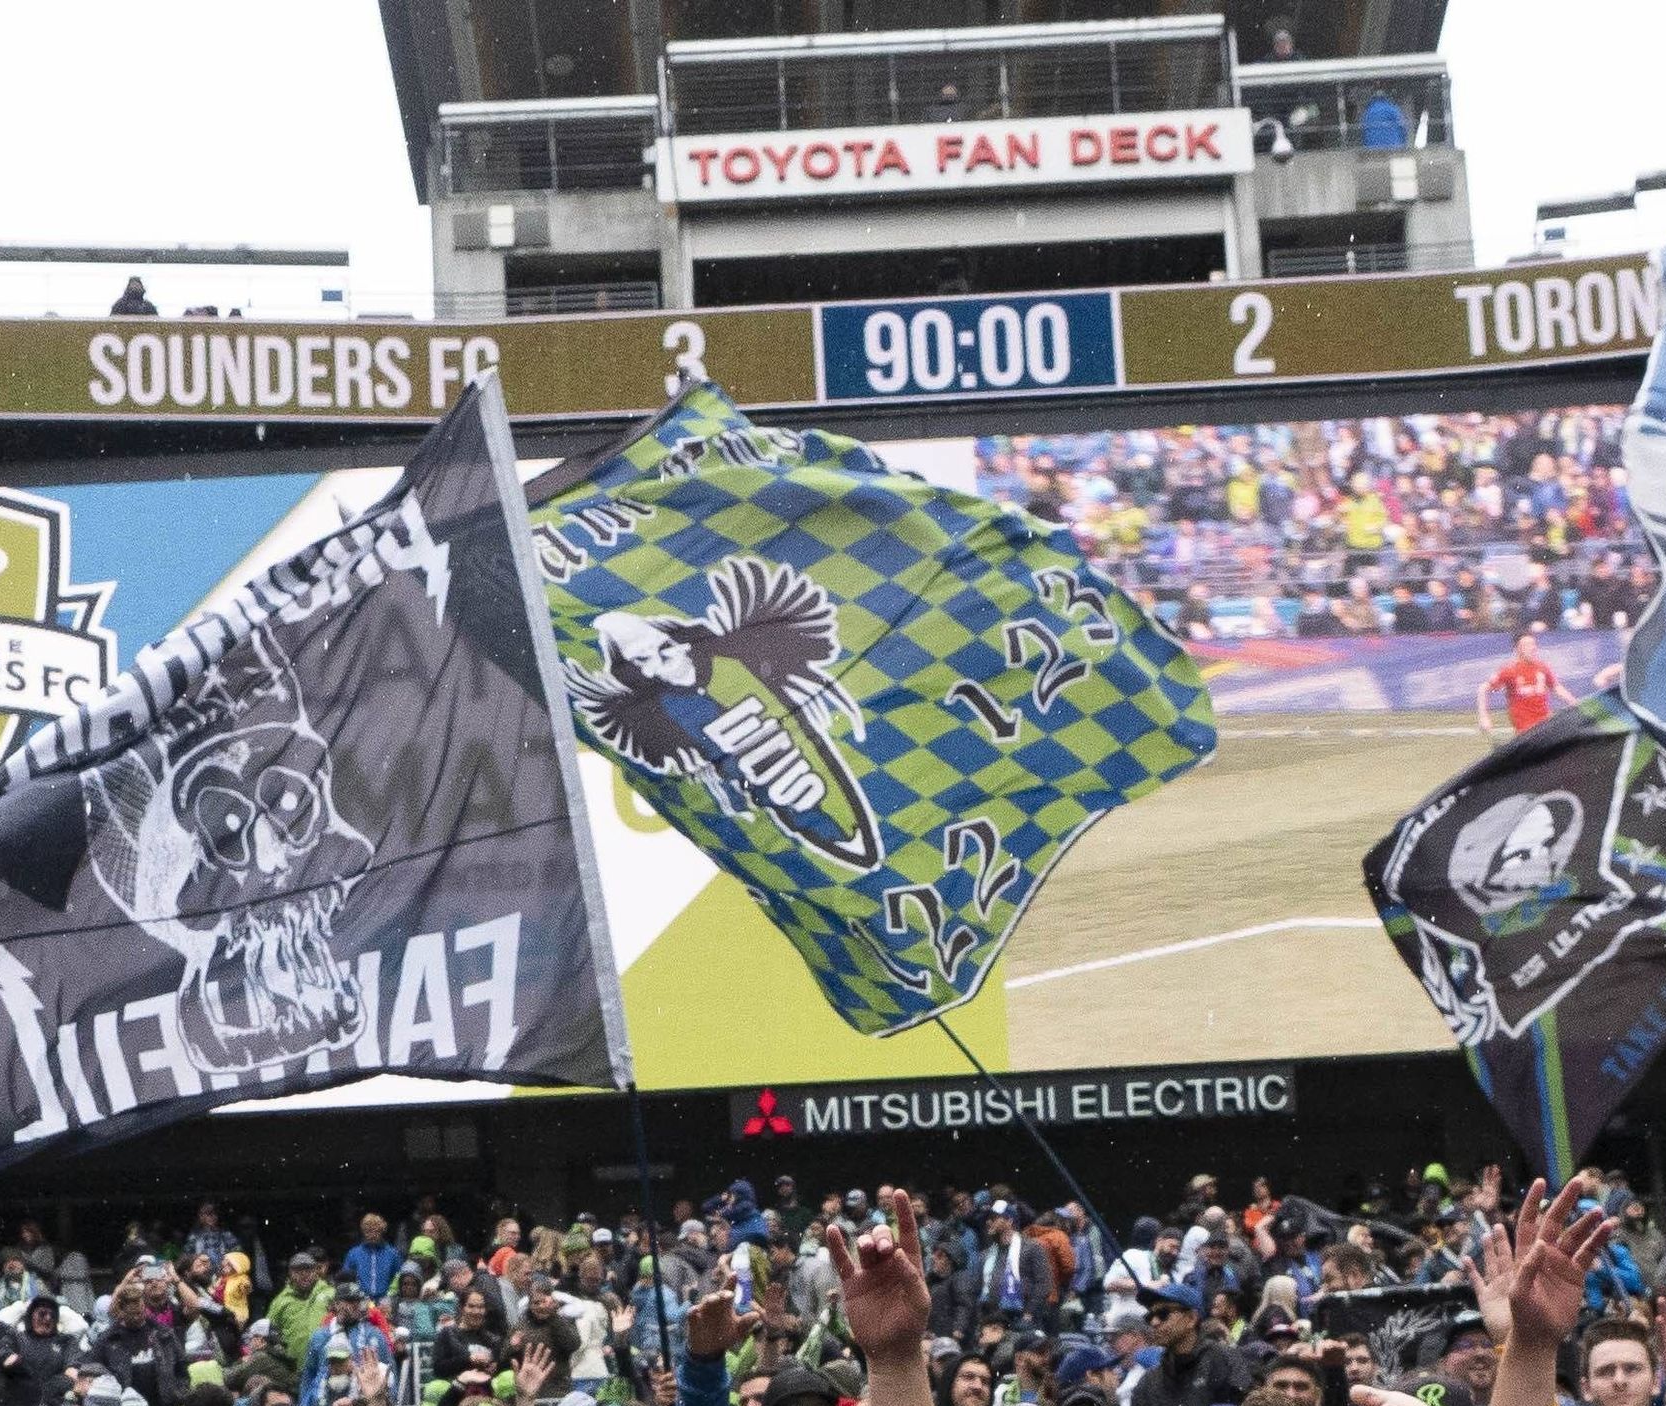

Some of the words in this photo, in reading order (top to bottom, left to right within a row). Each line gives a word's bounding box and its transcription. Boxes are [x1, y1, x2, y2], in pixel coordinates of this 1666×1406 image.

[689, 139, 911, 186] TOYOTA
[936, 131, 1041, 174] FAN
[1069, 122, 1222, 168] DECK
[88, 333, 411, 409] SOUNDERS
[662, 321, 707, 395] 3
[863, 301, 1071, 396] 90:00
[1231, 292, 1276, 376] 2
[42, 666, 101, 705] FC
[945, 567, 1119, 744] 123
[804, 1087, 1057, 1134] MITSUBISHI
[1072, 1073, 1290, 1120] ELECTRIC
